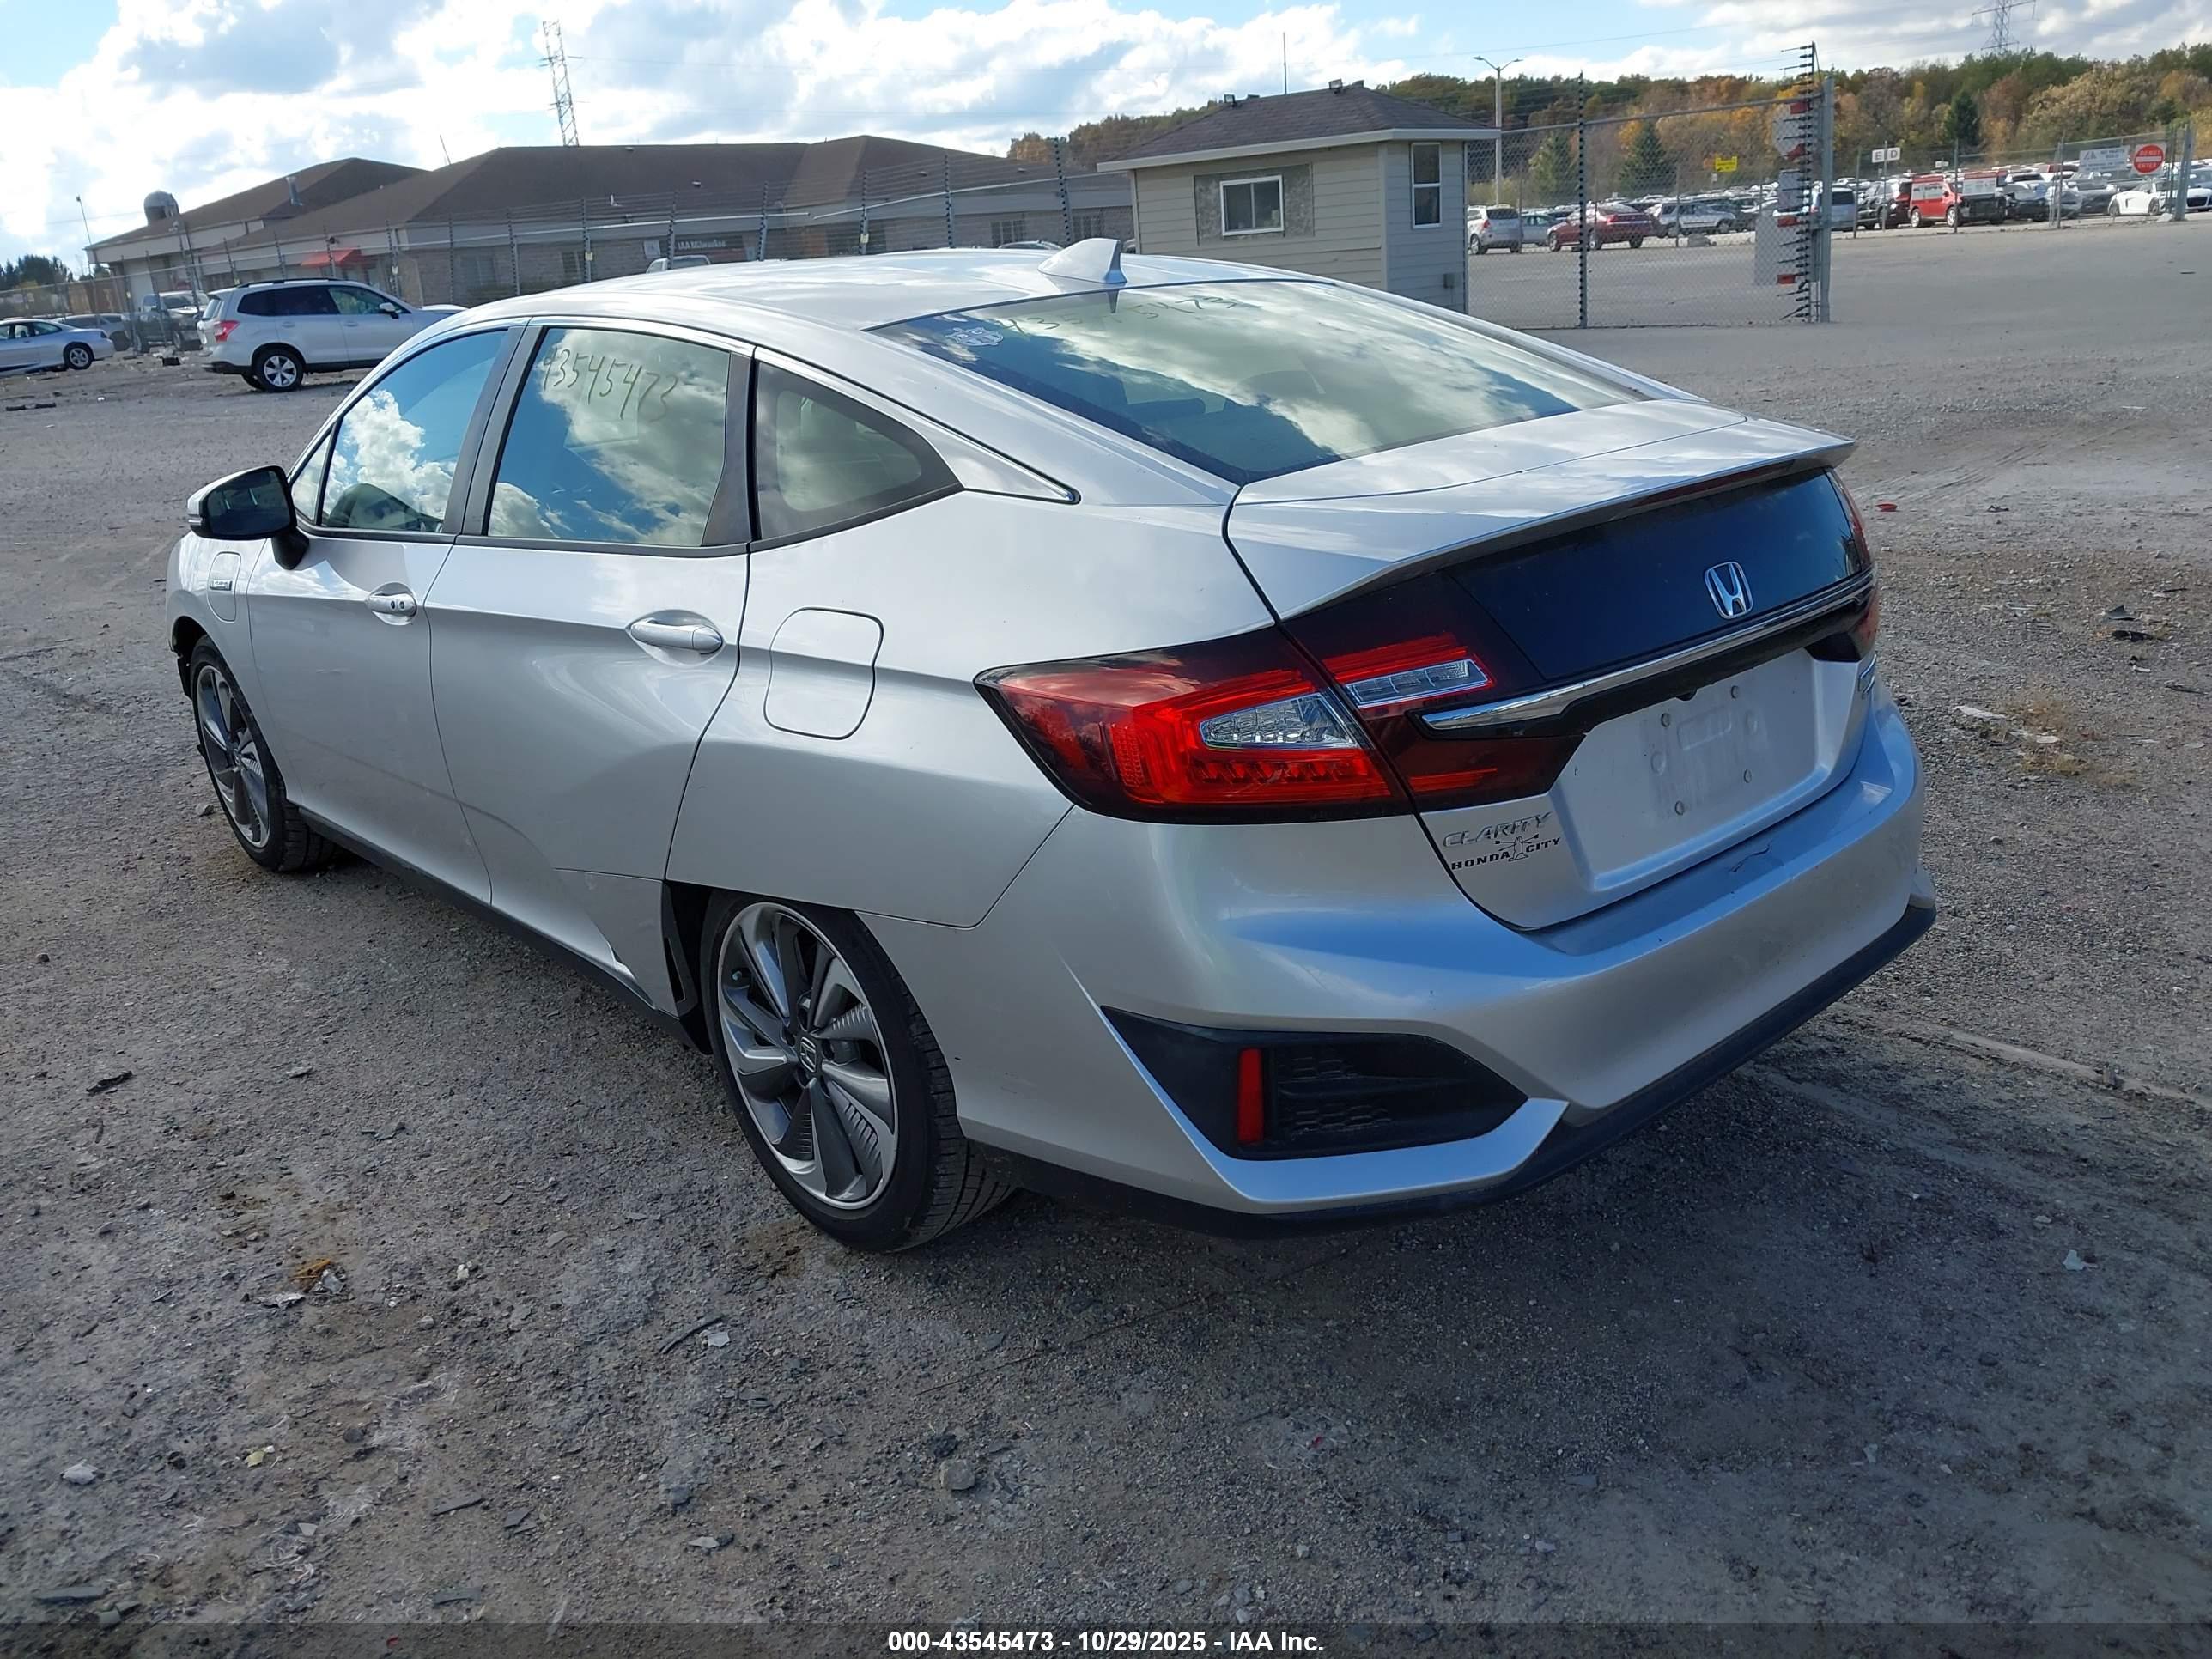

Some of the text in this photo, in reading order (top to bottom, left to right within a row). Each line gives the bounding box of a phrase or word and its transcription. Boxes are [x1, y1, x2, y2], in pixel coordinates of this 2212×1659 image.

[1890, 149, 1898, 158] D
[1443, 811, 1553, 848] CLARITY
[1450, 836, 1561, 871] HONDA CITY
